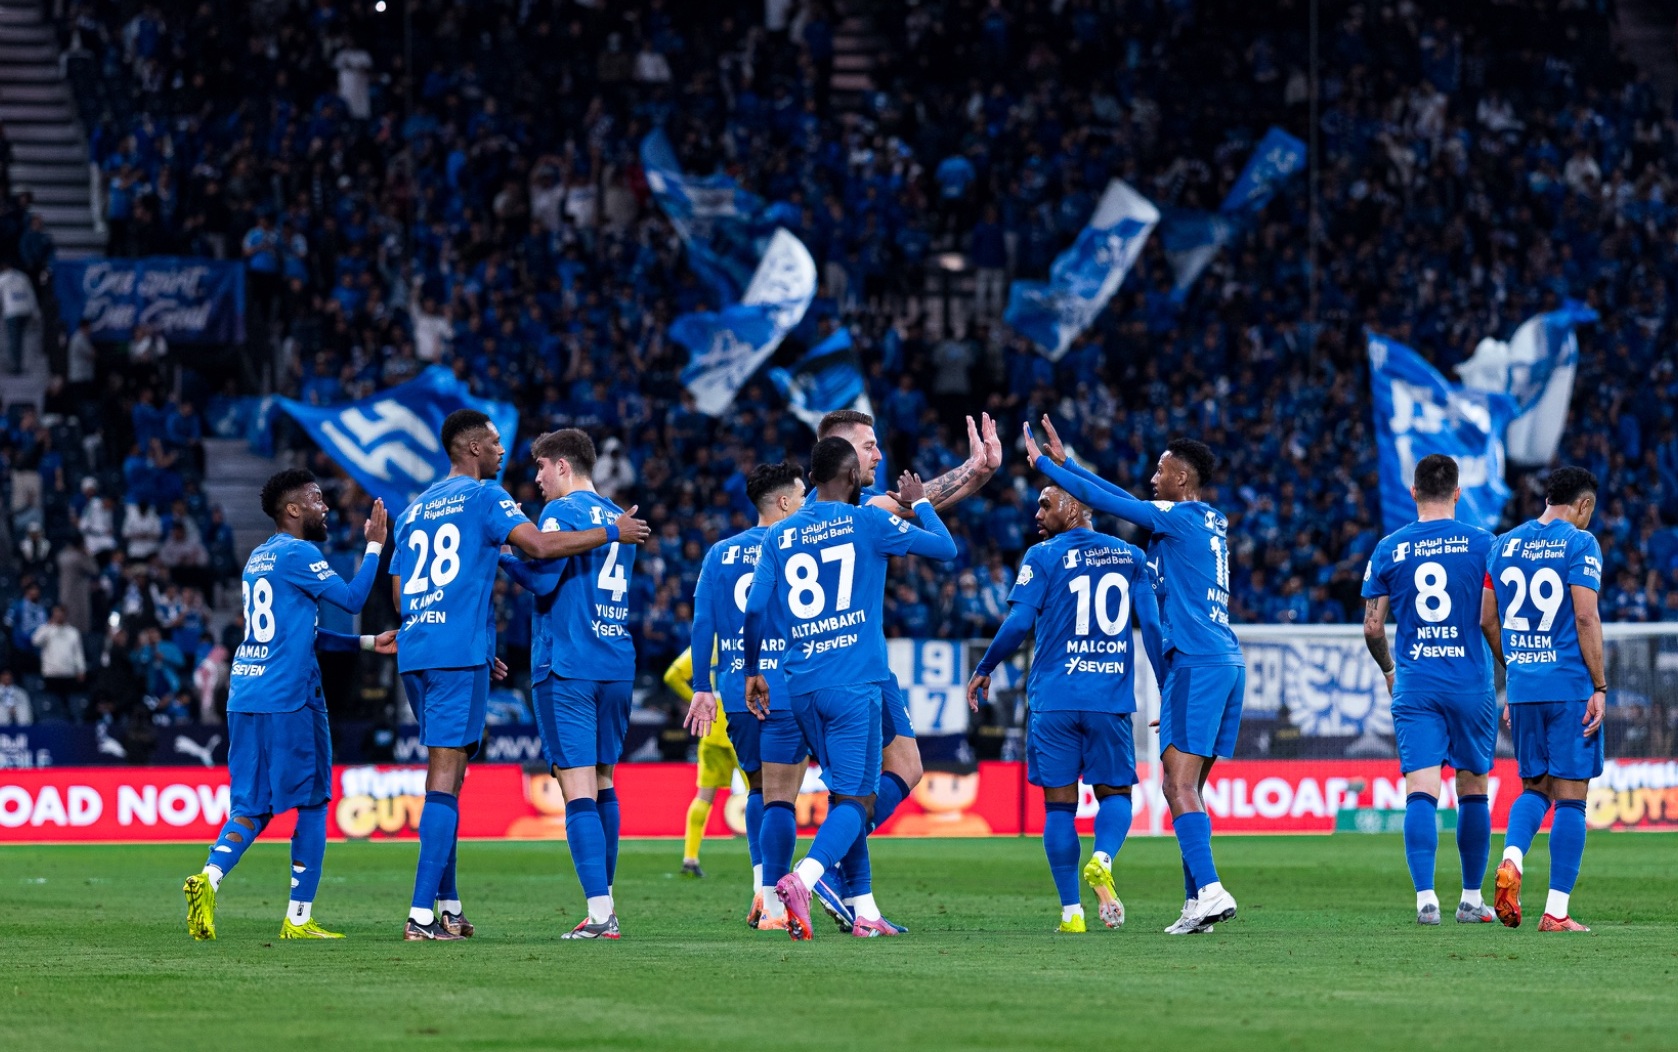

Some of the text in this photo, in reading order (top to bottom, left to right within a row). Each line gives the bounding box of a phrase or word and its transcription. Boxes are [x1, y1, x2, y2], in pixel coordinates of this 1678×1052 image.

[424, 504, 464, 520] Riyad Bank
[801, 515, 853, 535] بنك الرياض
[802, 525, 854, 545] Riyad Bank
[1414, 536, 1469, 548] بنك الرياض
[403, 522, 460, 595] 28
[1414, 545, 1469, 557] Riyad Bank
[1521, 549, 1565, 561] Riyad Bank
[1085, 555, 1134, 567] Riyad Bank
[1210, 535, 1230, 594] 1
[597, 541, 628, 602] 4
[784, 542, 856, 619] 87
[1414, 561, 1452, 622] 8
[1499, 566, 1564, 631] 29
[595, 603, 629, 621] YUSUF
[1068, 572, 1130, 636] 10
[600, 624, 631, 637] SEV
[791, 609, 866, 639] ALTAMBAKTI
[1417, 626, 1458, 640] NEVES
[1510, 633, 1552, 649] SALEM
[235, 644, 269, 659] AMAD
[815, 633, 858, 654] SEVEN
[1066, 640, 1127, 654] MALCOM
[1422, 645, 1465, 658] SEVEN
[734, 658, 778, 671] SEN
[1517, 650, 1557, 665] SEVEN
[232, 664, 266, 677] SEVEN
[1077, 660, 1124, 674] SEVEN
[926, 691, 948, 731] 7
[0, 783, 231, 828] OAD NOW
[336, 794, 426, 838] GUY
